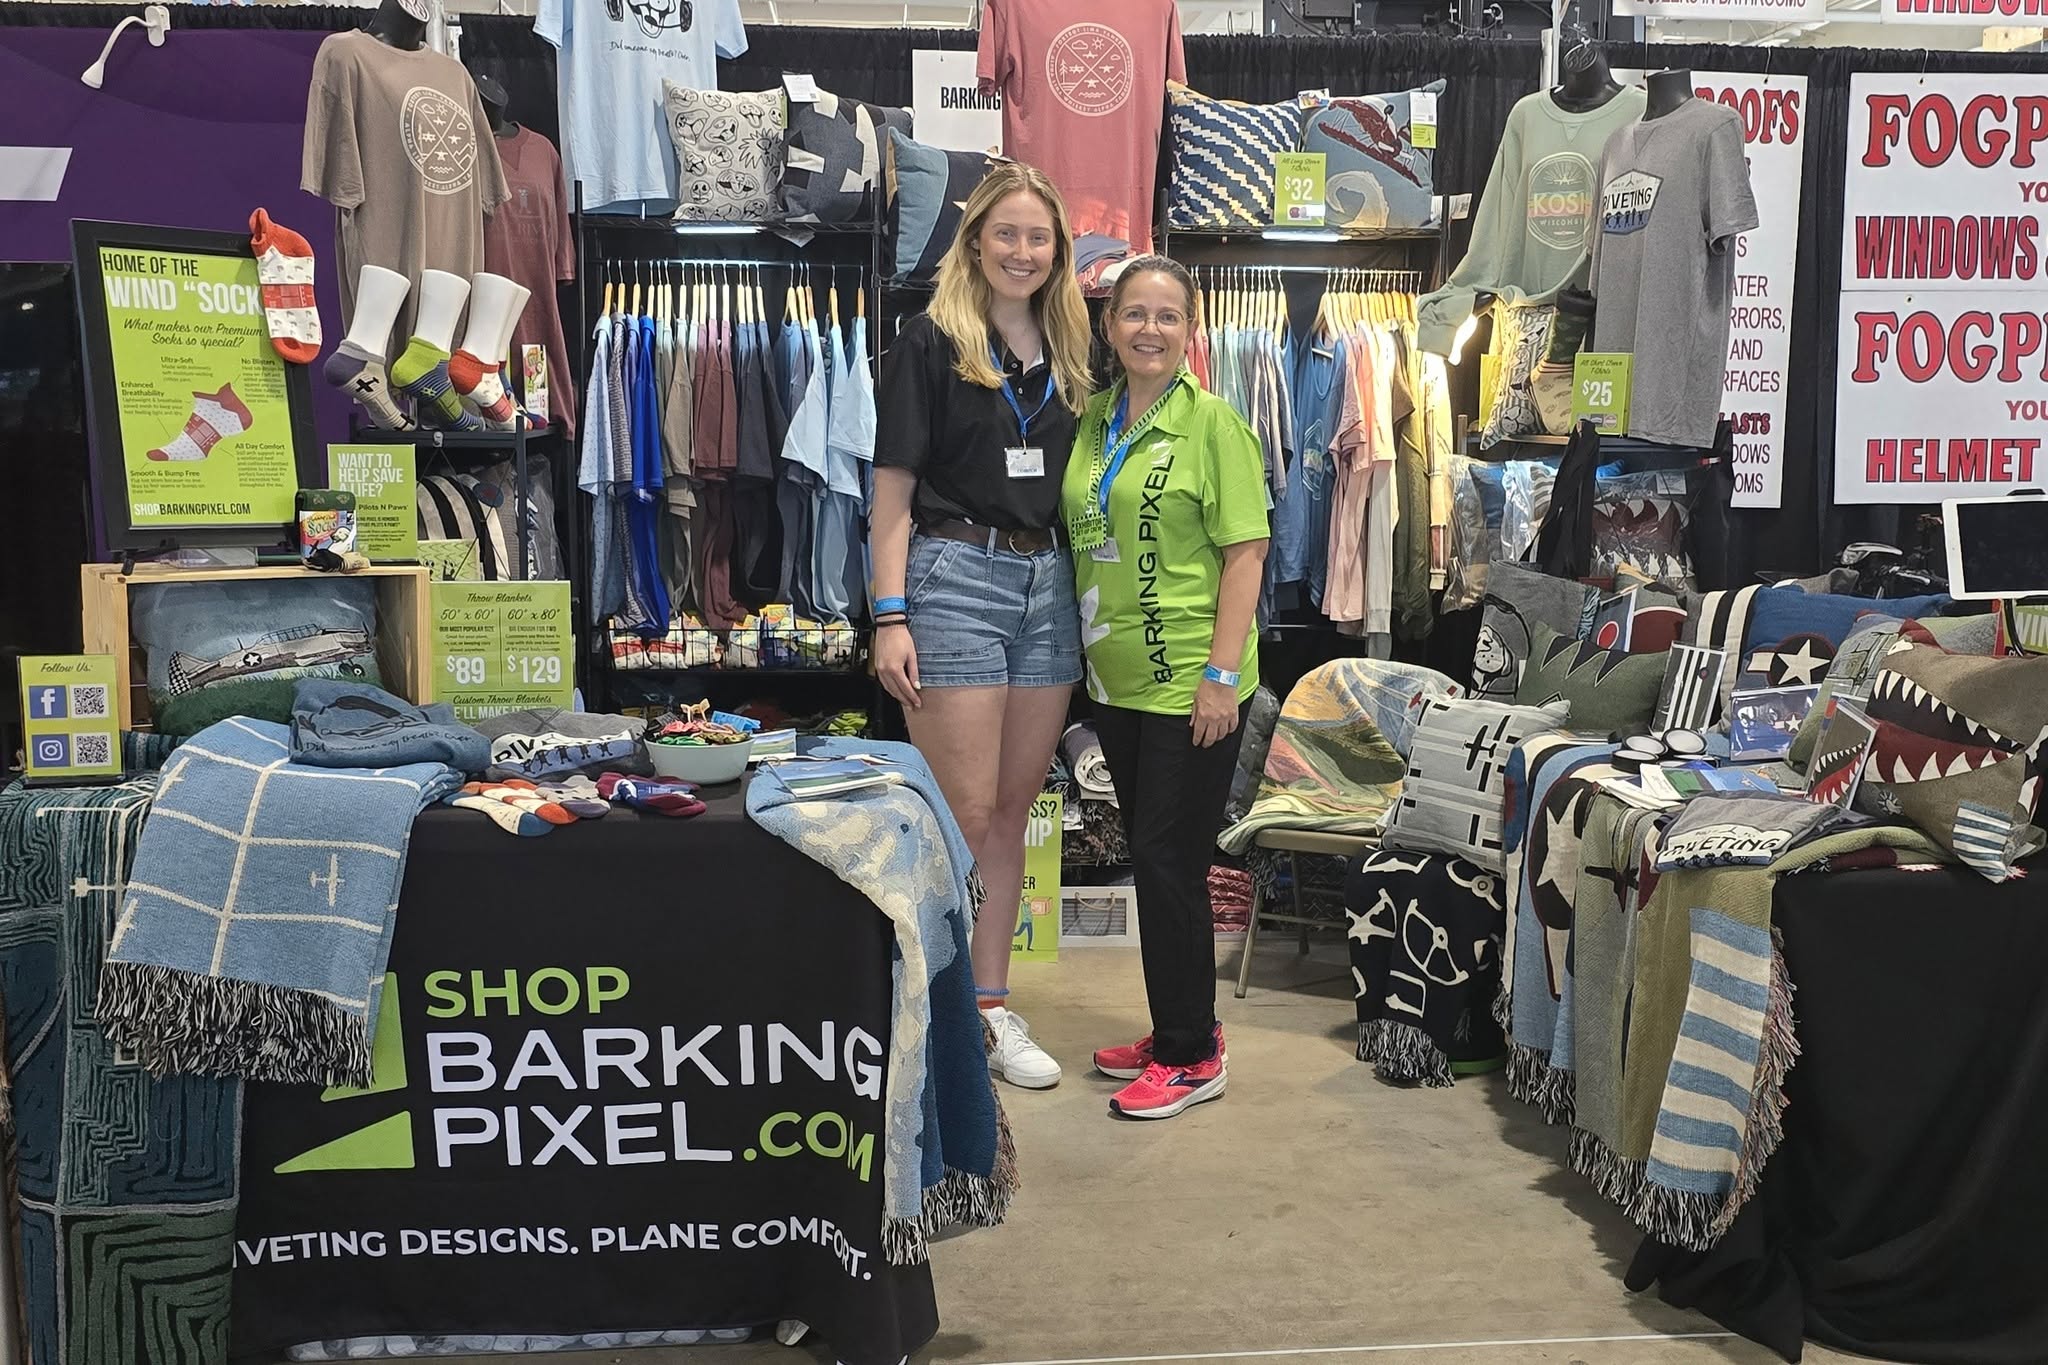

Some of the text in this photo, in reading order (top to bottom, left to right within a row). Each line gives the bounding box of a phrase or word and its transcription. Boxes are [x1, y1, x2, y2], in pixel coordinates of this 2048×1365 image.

[941, 86, 1000, 110] BARKING
[1695, 87, 1800, 145] OFS
[1284, 176, 1313, 201] $32
[1855, 215, 2039, 280] WINDOWS
[102, 252, 199, 277] HOME OF THE
[104, 276, 177, 311] WIND
[1733, 275, 1768, 297] ATER
[124, 318, 264, 338] What makes our Premium
[1730, 307, 1786, 333] RRORS,
[152, 332, 245, 350] Socks so special?
[1730, 339, 1763, 360] AND
[1851, 310, 2048, 384] FOGP
[160, 356, 194, 364] Ultra-Soft
[1723, 371, 1780, 392] RFACES
[122, 389, 165, 398] Breathability
[1582, 379, 1612, 406] $25
[338, 453, 392, 468] WANT TO
[1732, 444, 1770, 464] DOWS
[1866, 438, 2041, 483] HELMET
[338, 468, 404, 482] HELP SAVE
[1734, 473, 1763, 493] OMS
[352, 483, 384, 497] LIFE?
[134, 502, 251, 516] SHOPBARKINGPIXEL.COM
[1076, 518, 1102, 530] EXHIBITOR
[1138, 454, 1175, 684] BARKING PIXEL
[467, 593, 532, 603] Throw Blankets
[40, 663, 73, 672] Follow
[447, 655, 485, 684] $89
[507, 655, 561, 684] $129
[453, 694, 552, 705] Custom Throw Blankets
[454, 706, 476, 720] E'LL
[304, 741, 326, 752] Did
[1030, 800, 1057, 818] SS?
[1022, 876, 1036, 890] ER
[424, 965, 632, 1019] SHOP
[425, 1020, 883, 1102] BARKING
[432, 1101, 876, 1184] PIXEL.COM
[232, 1213, 873, 1283] VETING DESIGNS. PLANE COMFORT.
